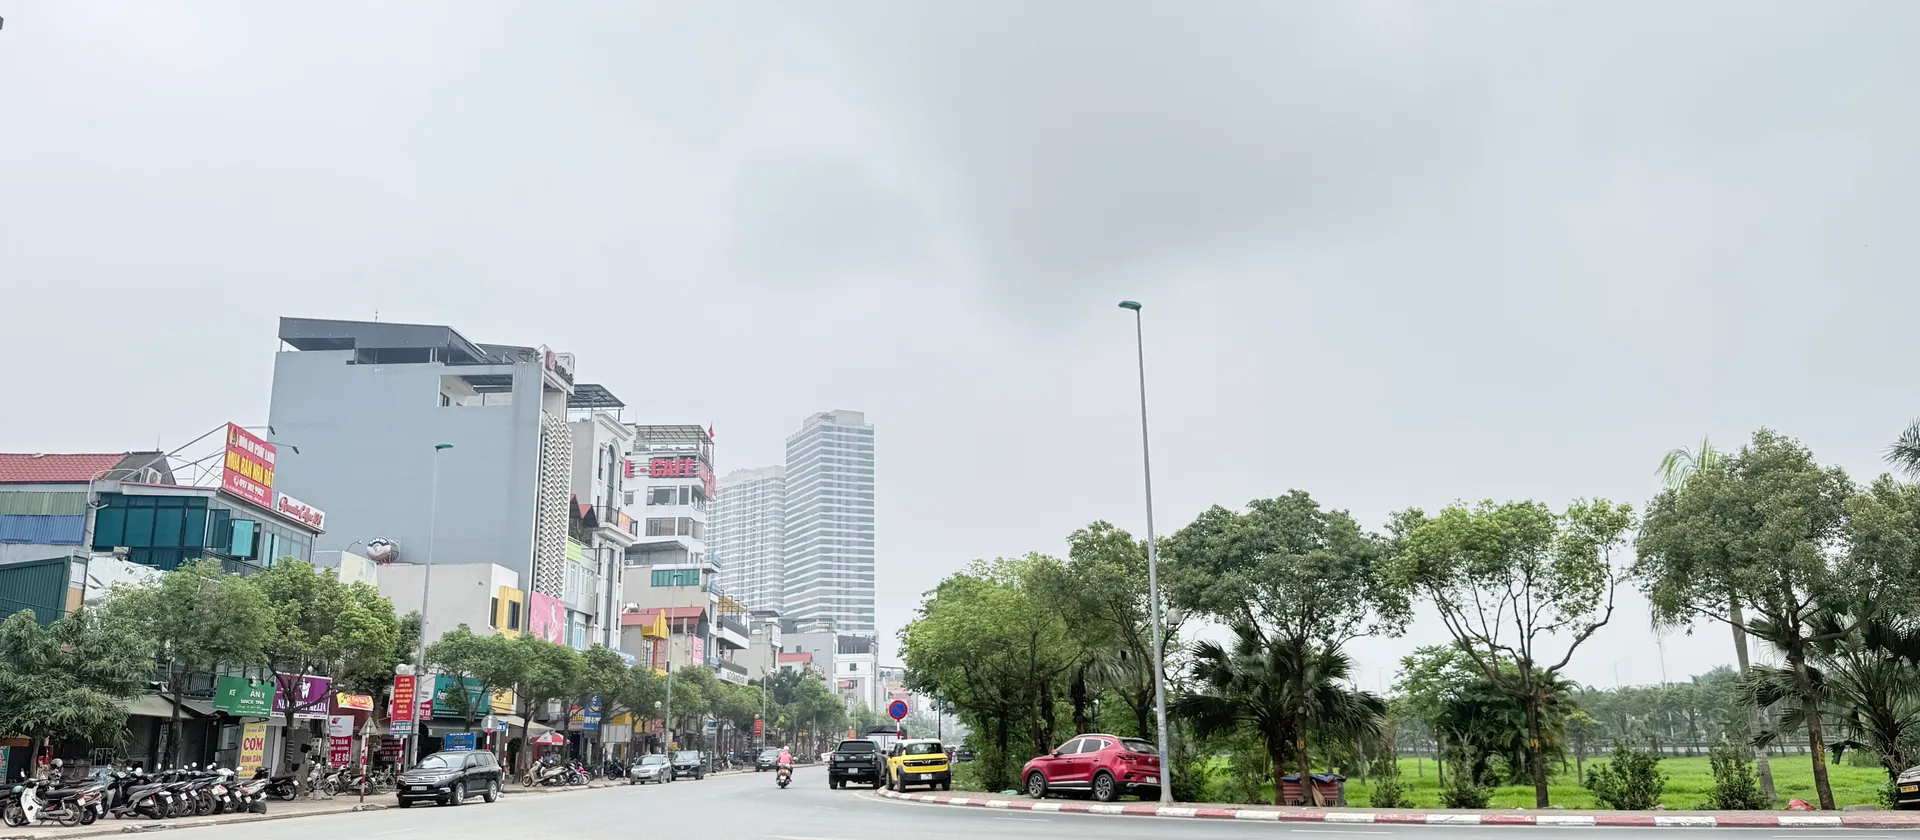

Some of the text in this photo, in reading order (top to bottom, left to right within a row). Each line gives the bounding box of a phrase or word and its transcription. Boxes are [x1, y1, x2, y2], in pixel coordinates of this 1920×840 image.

[226, 450, 240, 472] MUA
[240, 455, 252, 479] BÁN
[252, 463, 264, 484] NHÀ
